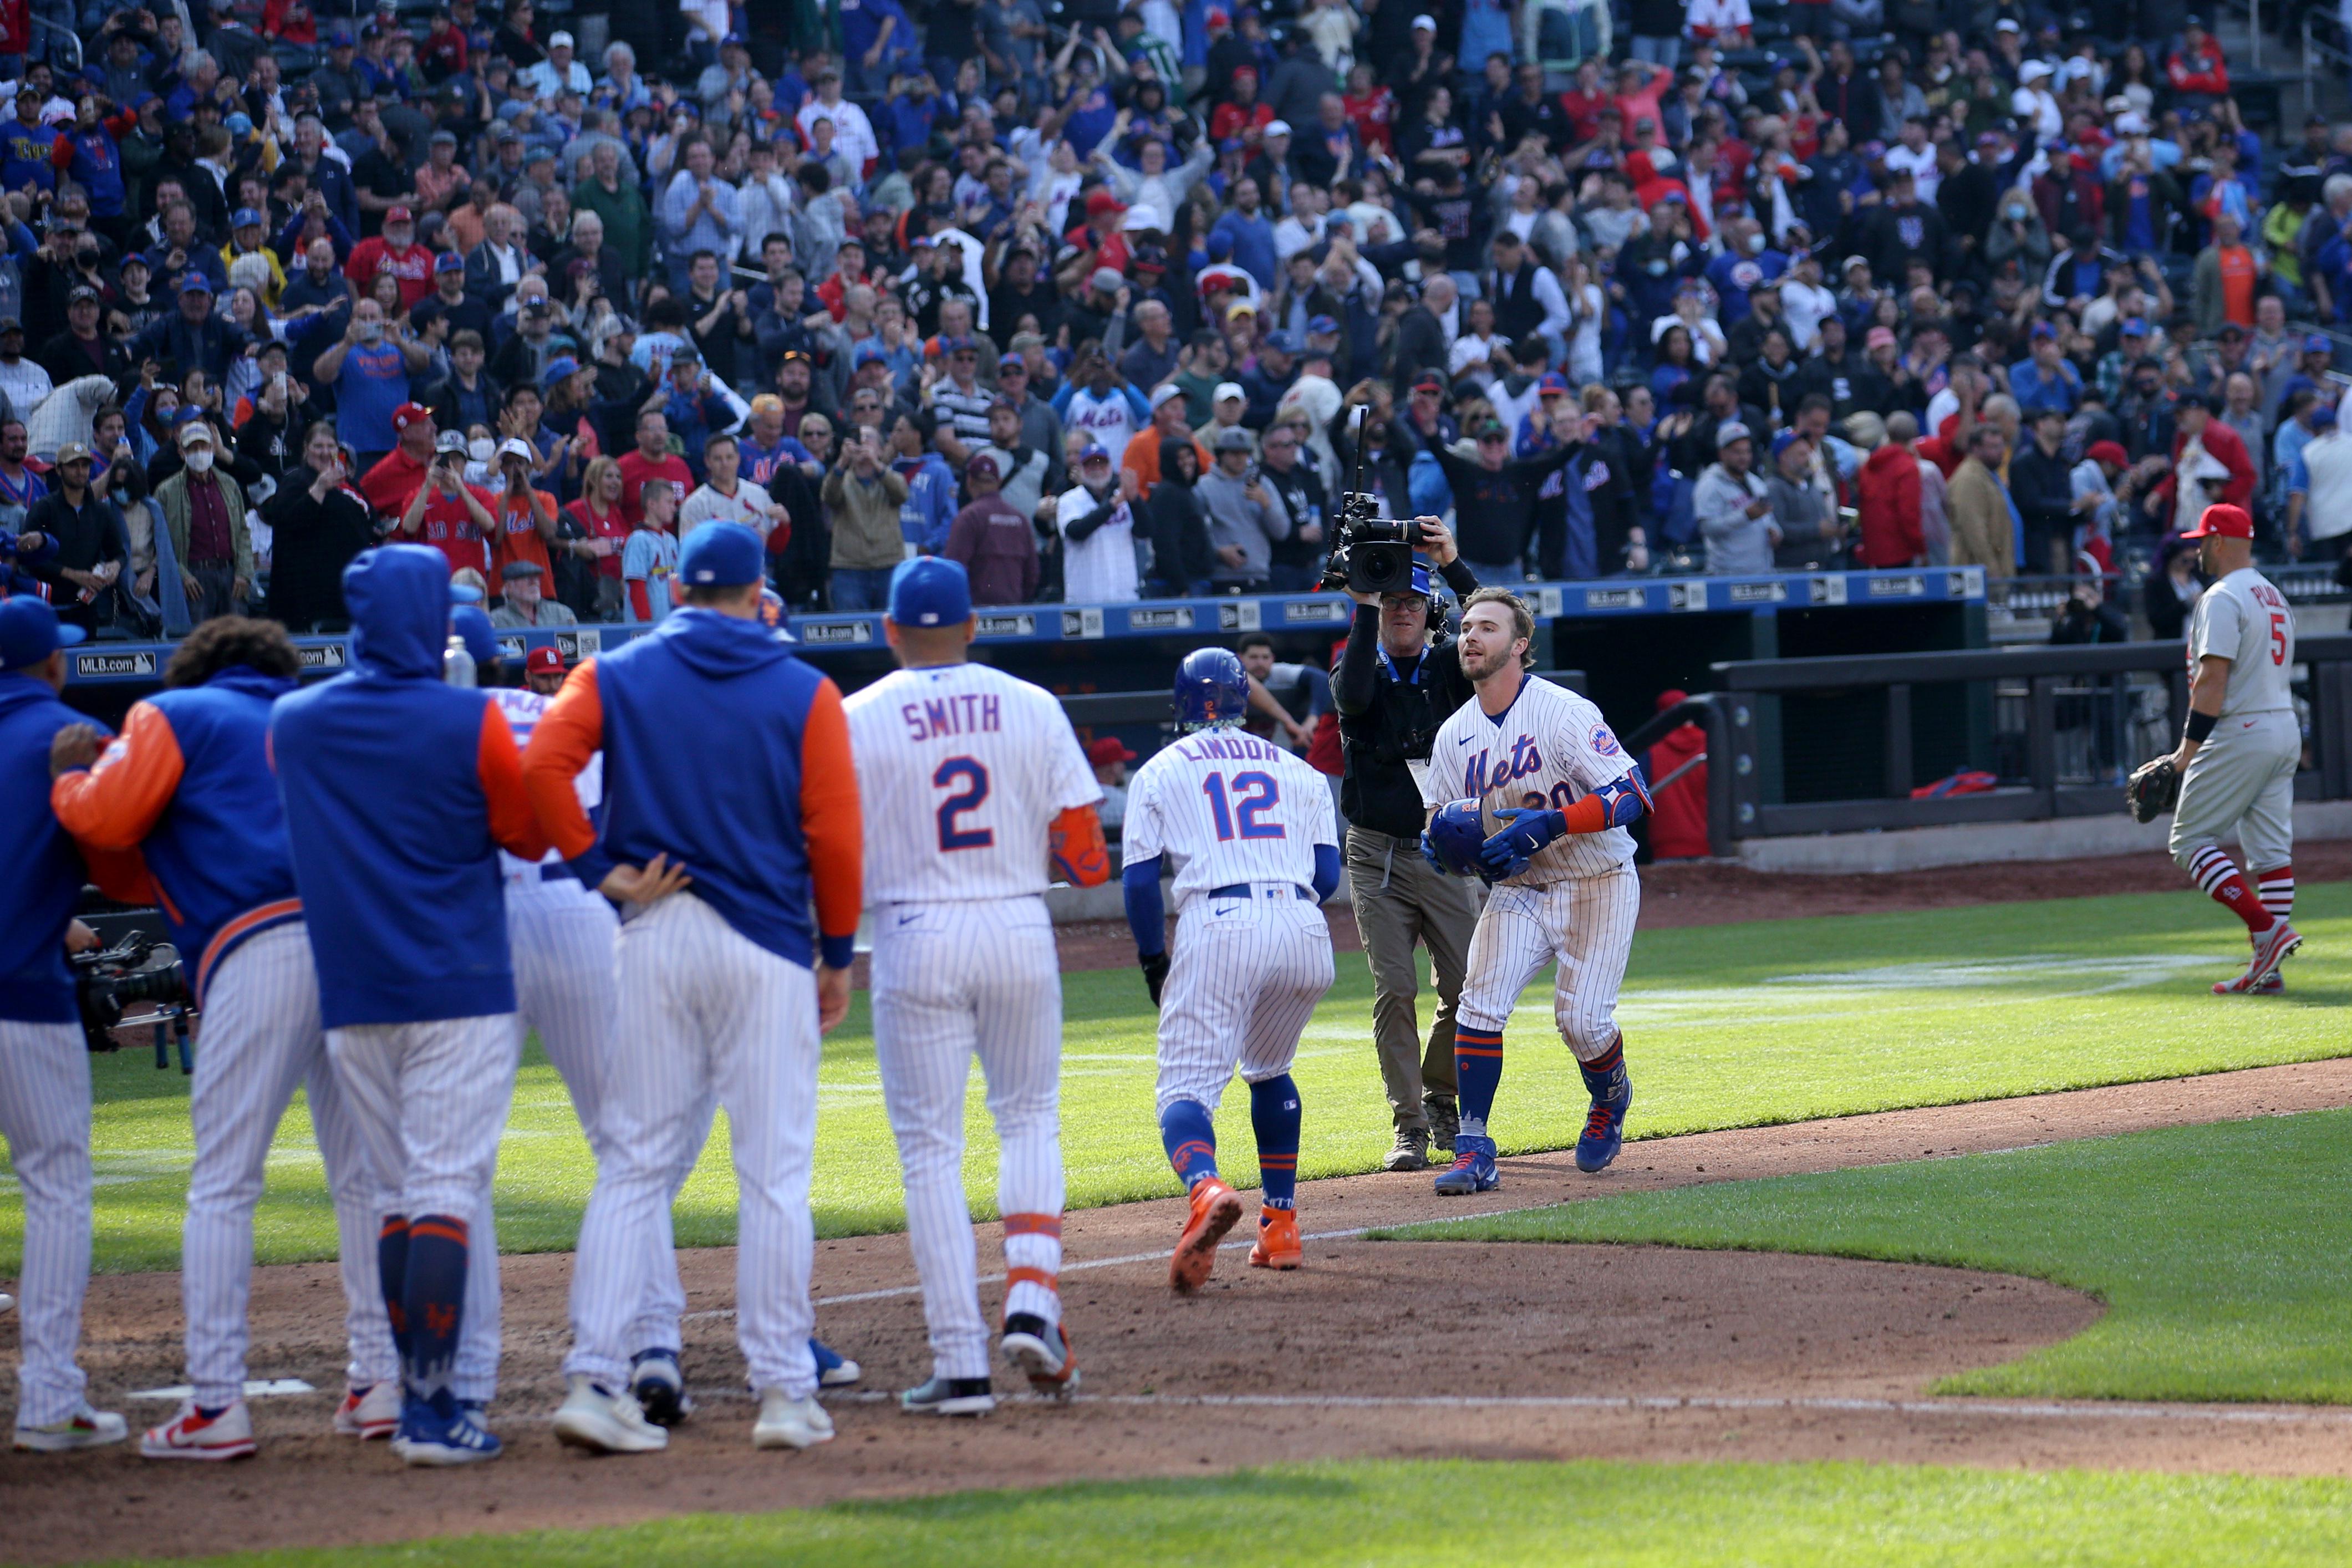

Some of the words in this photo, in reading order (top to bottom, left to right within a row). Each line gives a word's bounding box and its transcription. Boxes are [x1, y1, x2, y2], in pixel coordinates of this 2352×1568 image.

[1077, 408, 1122, 426] Mets
[507, 510, 535, 534] Met
[806, 624, 853, 642] MLB.com
[2270, 613, 2287, 666] 5
[80, 659, 133, 673] MLB.com
[902, 694, 1000, 742] SMITH
[1175, 739, 1280, 763] LINDOR
[1464, 734, 1542, 797] Mets
[932, 754, 995, 852] 2
[1202, 770, 1287, 842] 12
[1462, 803, 1470, 812] 20
